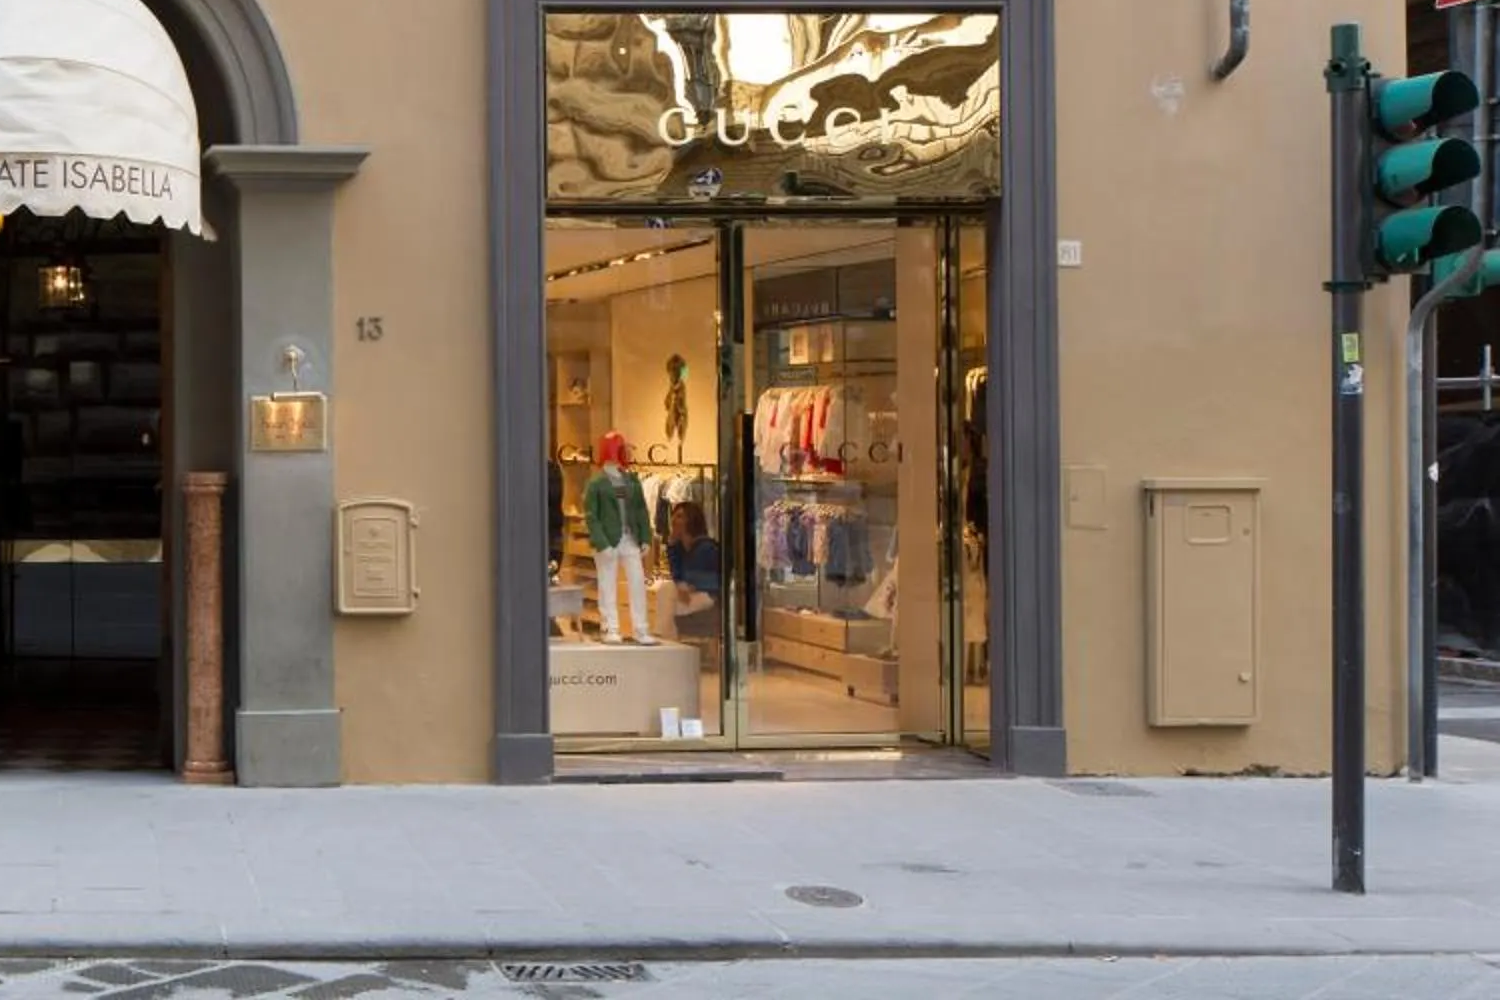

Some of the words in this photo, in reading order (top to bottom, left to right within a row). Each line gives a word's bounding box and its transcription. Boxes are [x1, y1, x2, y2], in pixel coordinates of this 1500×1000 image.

[658, 106, 893, 146] GUCCI
[62, 160, 173, 199] ISABELLA
[355, 317, 384, 342] 13
[549, 673, 618, 686] ucci.com
